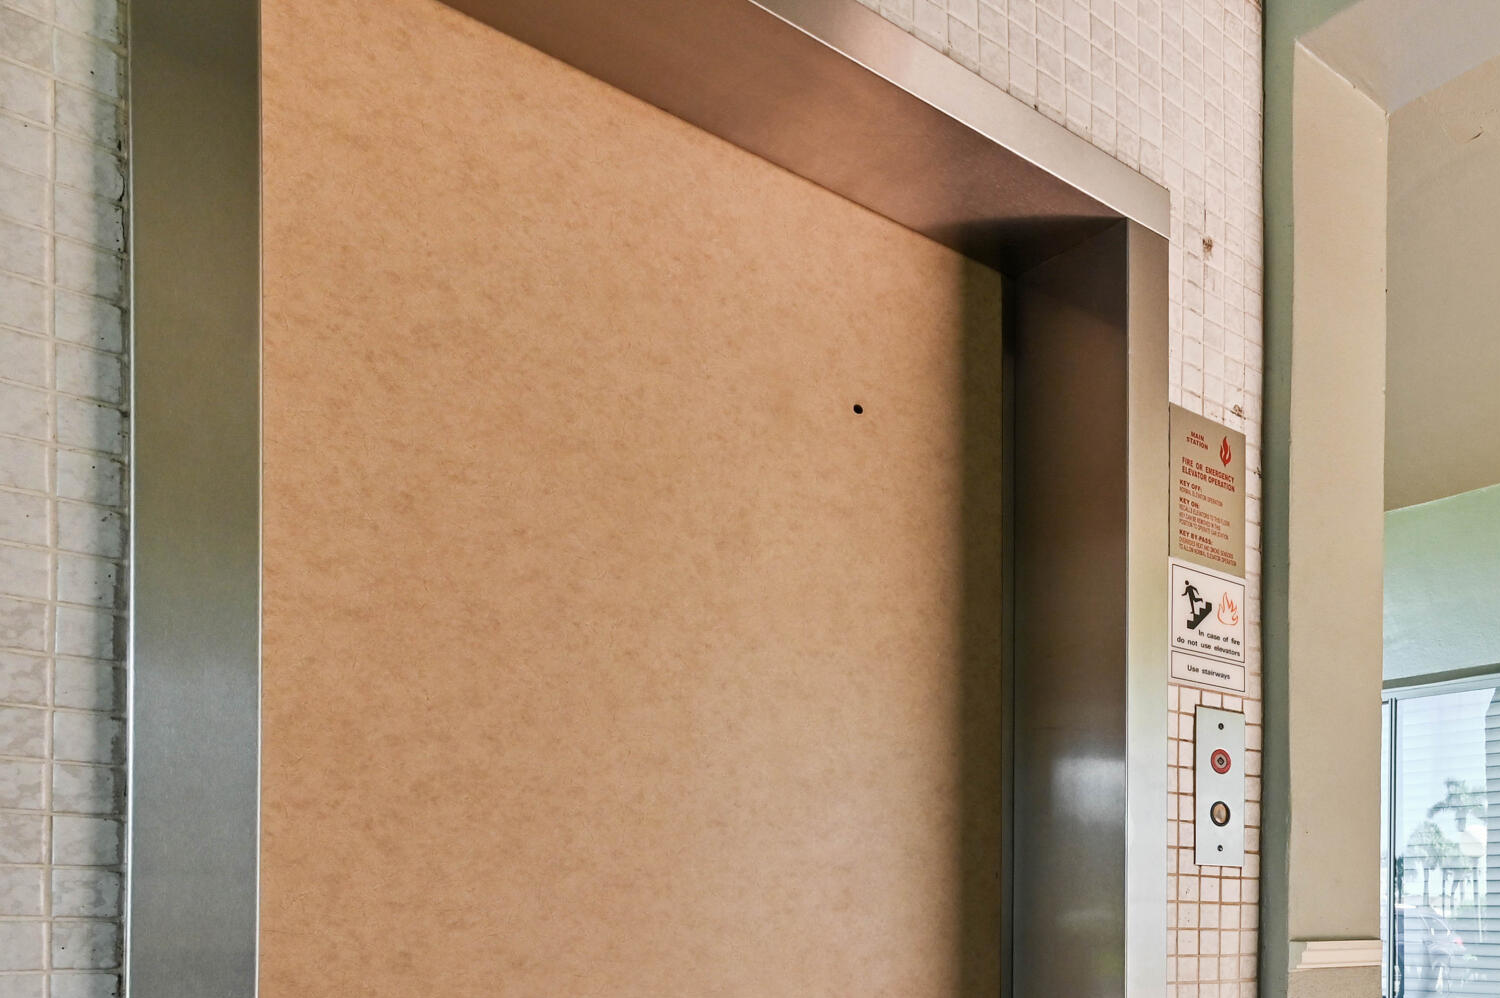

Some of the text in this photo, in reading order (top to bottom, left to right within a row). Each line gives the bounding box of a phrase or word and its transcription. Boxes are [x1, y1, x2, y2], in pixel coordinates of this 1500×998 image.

[1186, 436, 1209, 450] STATION
[1191, 431, 1205, 442] MAIN
[1182, 456, 1234, 483] FIRE OR EMERGENCY
[1180, 479, 1190, 487] KEY
[1182, 466, 1235, 492] ELEVATOR OPERATION
[1179, 496, 1190, 505] KEY
[1179, 529, 1190, 537] KEY
[1198, 629, 1205, 637] In
[1206, 633, 1221, 641] case
[1231, 637, 1241, 646] fire
[1176, 636, 1241, 657] do not use elevators
[1187, 664, 1231, 680] Use stairways
